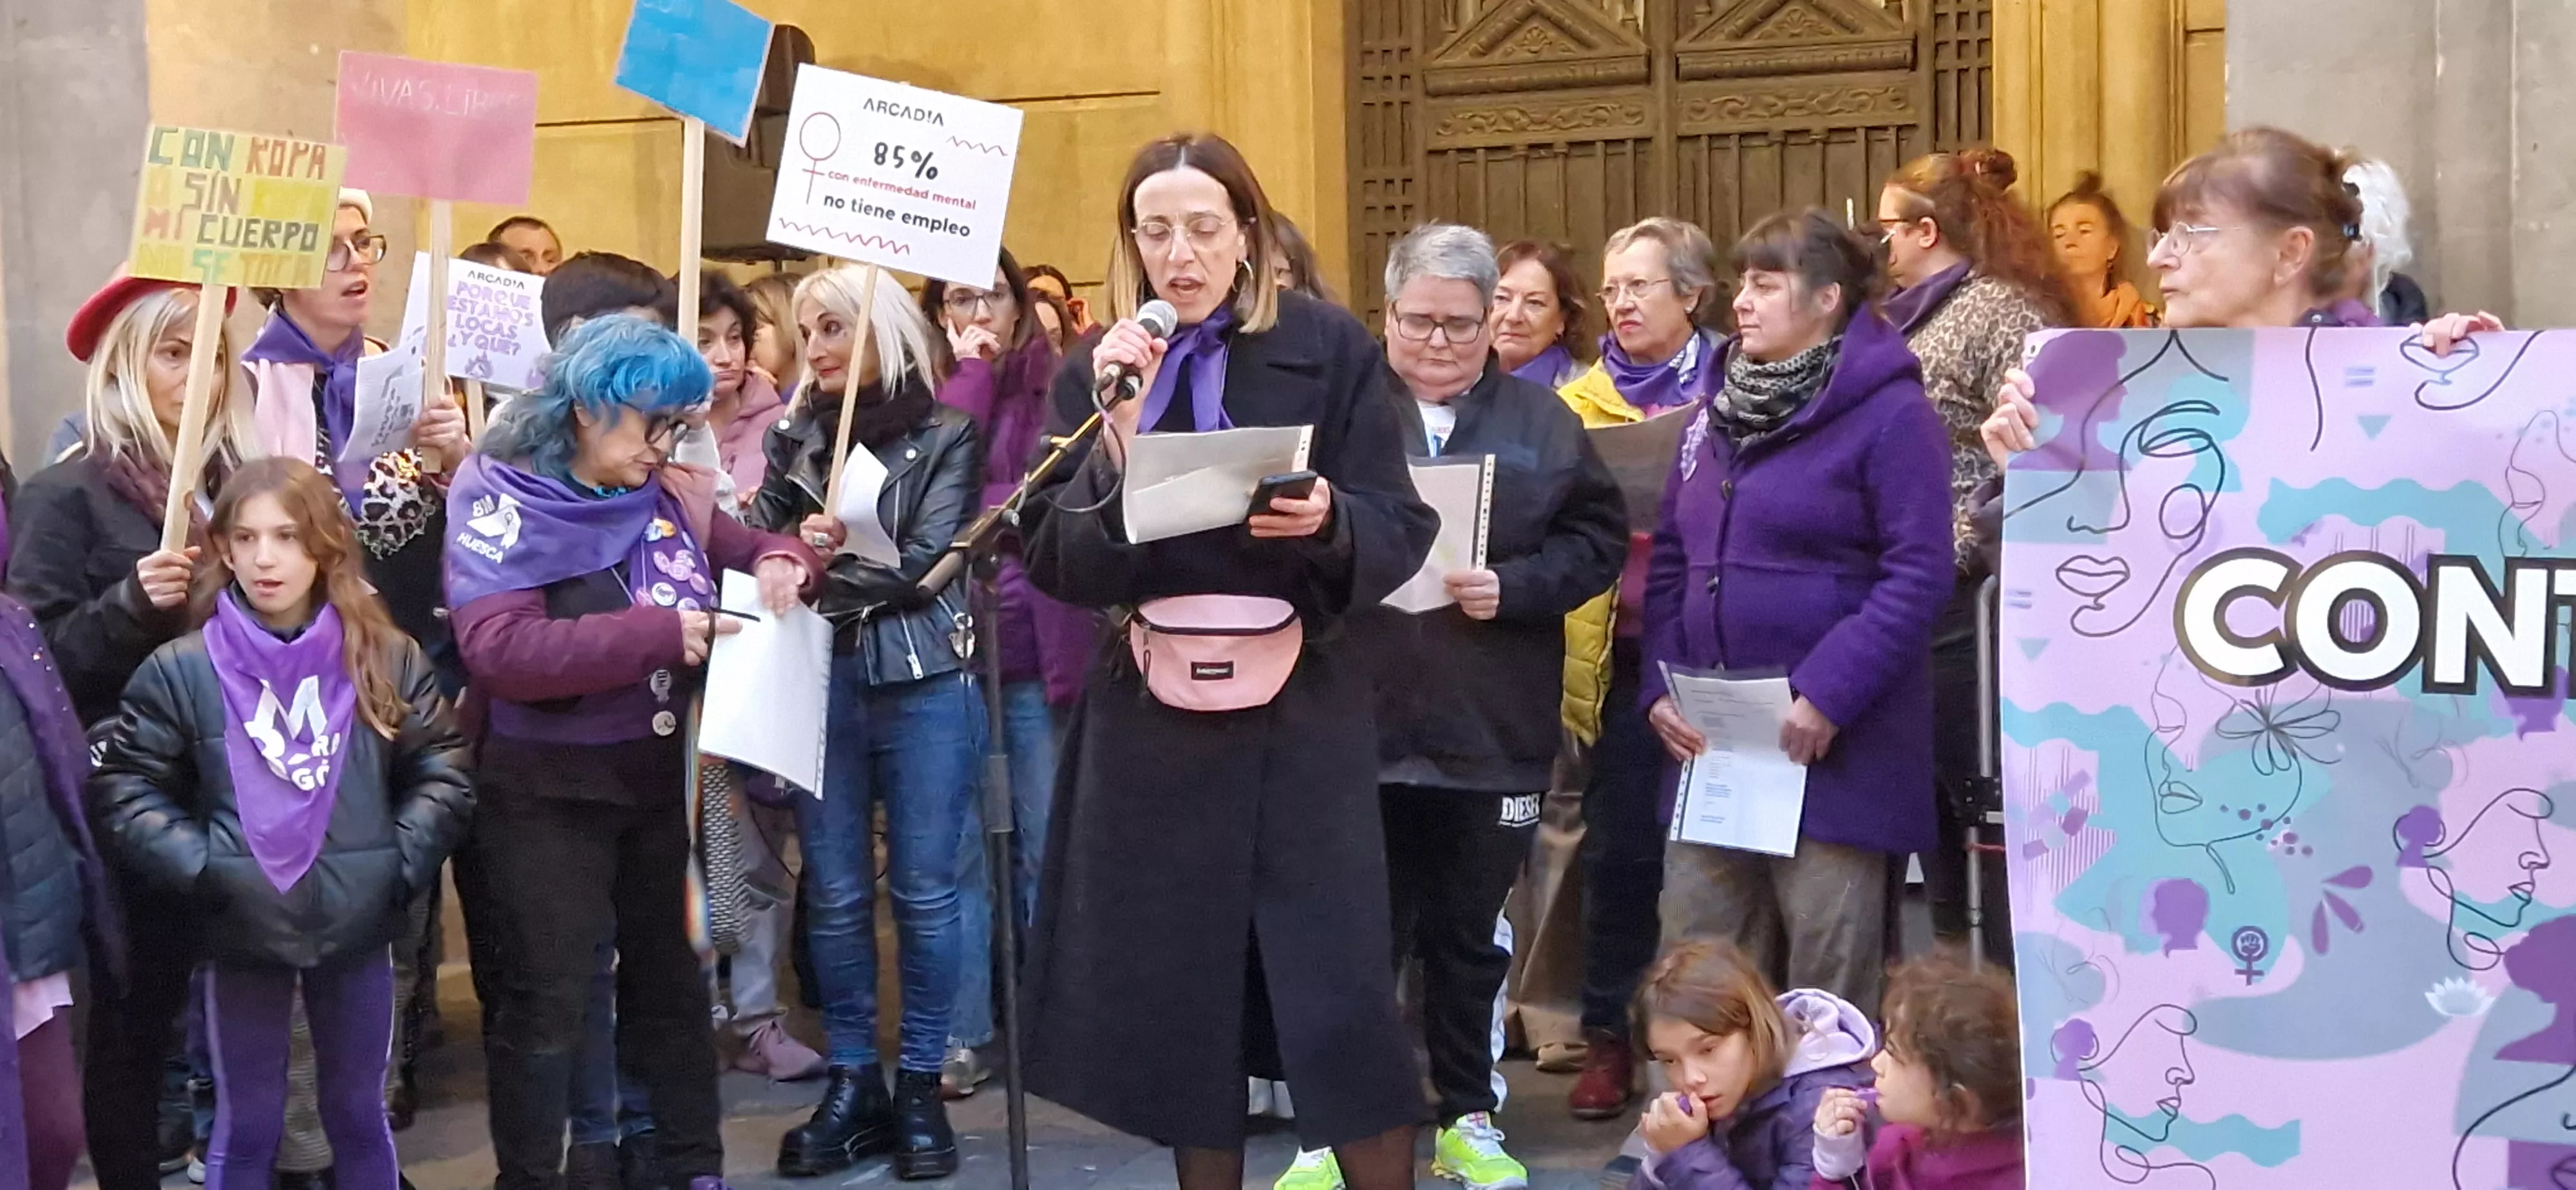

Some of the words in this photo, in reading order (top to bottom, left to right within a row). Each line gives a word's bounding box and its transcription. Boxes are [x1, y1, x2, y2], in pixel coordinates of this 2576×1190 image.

[147, 126, 235, 171] CON
[245, 136, 326, 180] ROPA
[873, 141, 939, 180] 85%
[182, 170, 242, 216] SIN
[828, 170, 849, 182] con
[852, 176, 930, 200] enfermedad
[932, 194, 977, 211] mental
[196, 213, 319, 252] CUERPO
[823, 194, 846, 209] no
[851, 198, 896, 221] tiene
[901, 212, 971, 238] empleo
[456, 280, 531, 310] PORQUE
[455, 313, 518, 339] LOCAS
[472, 494, 495, 517] 8M
[456, 532, 504, 564] HUESCA
